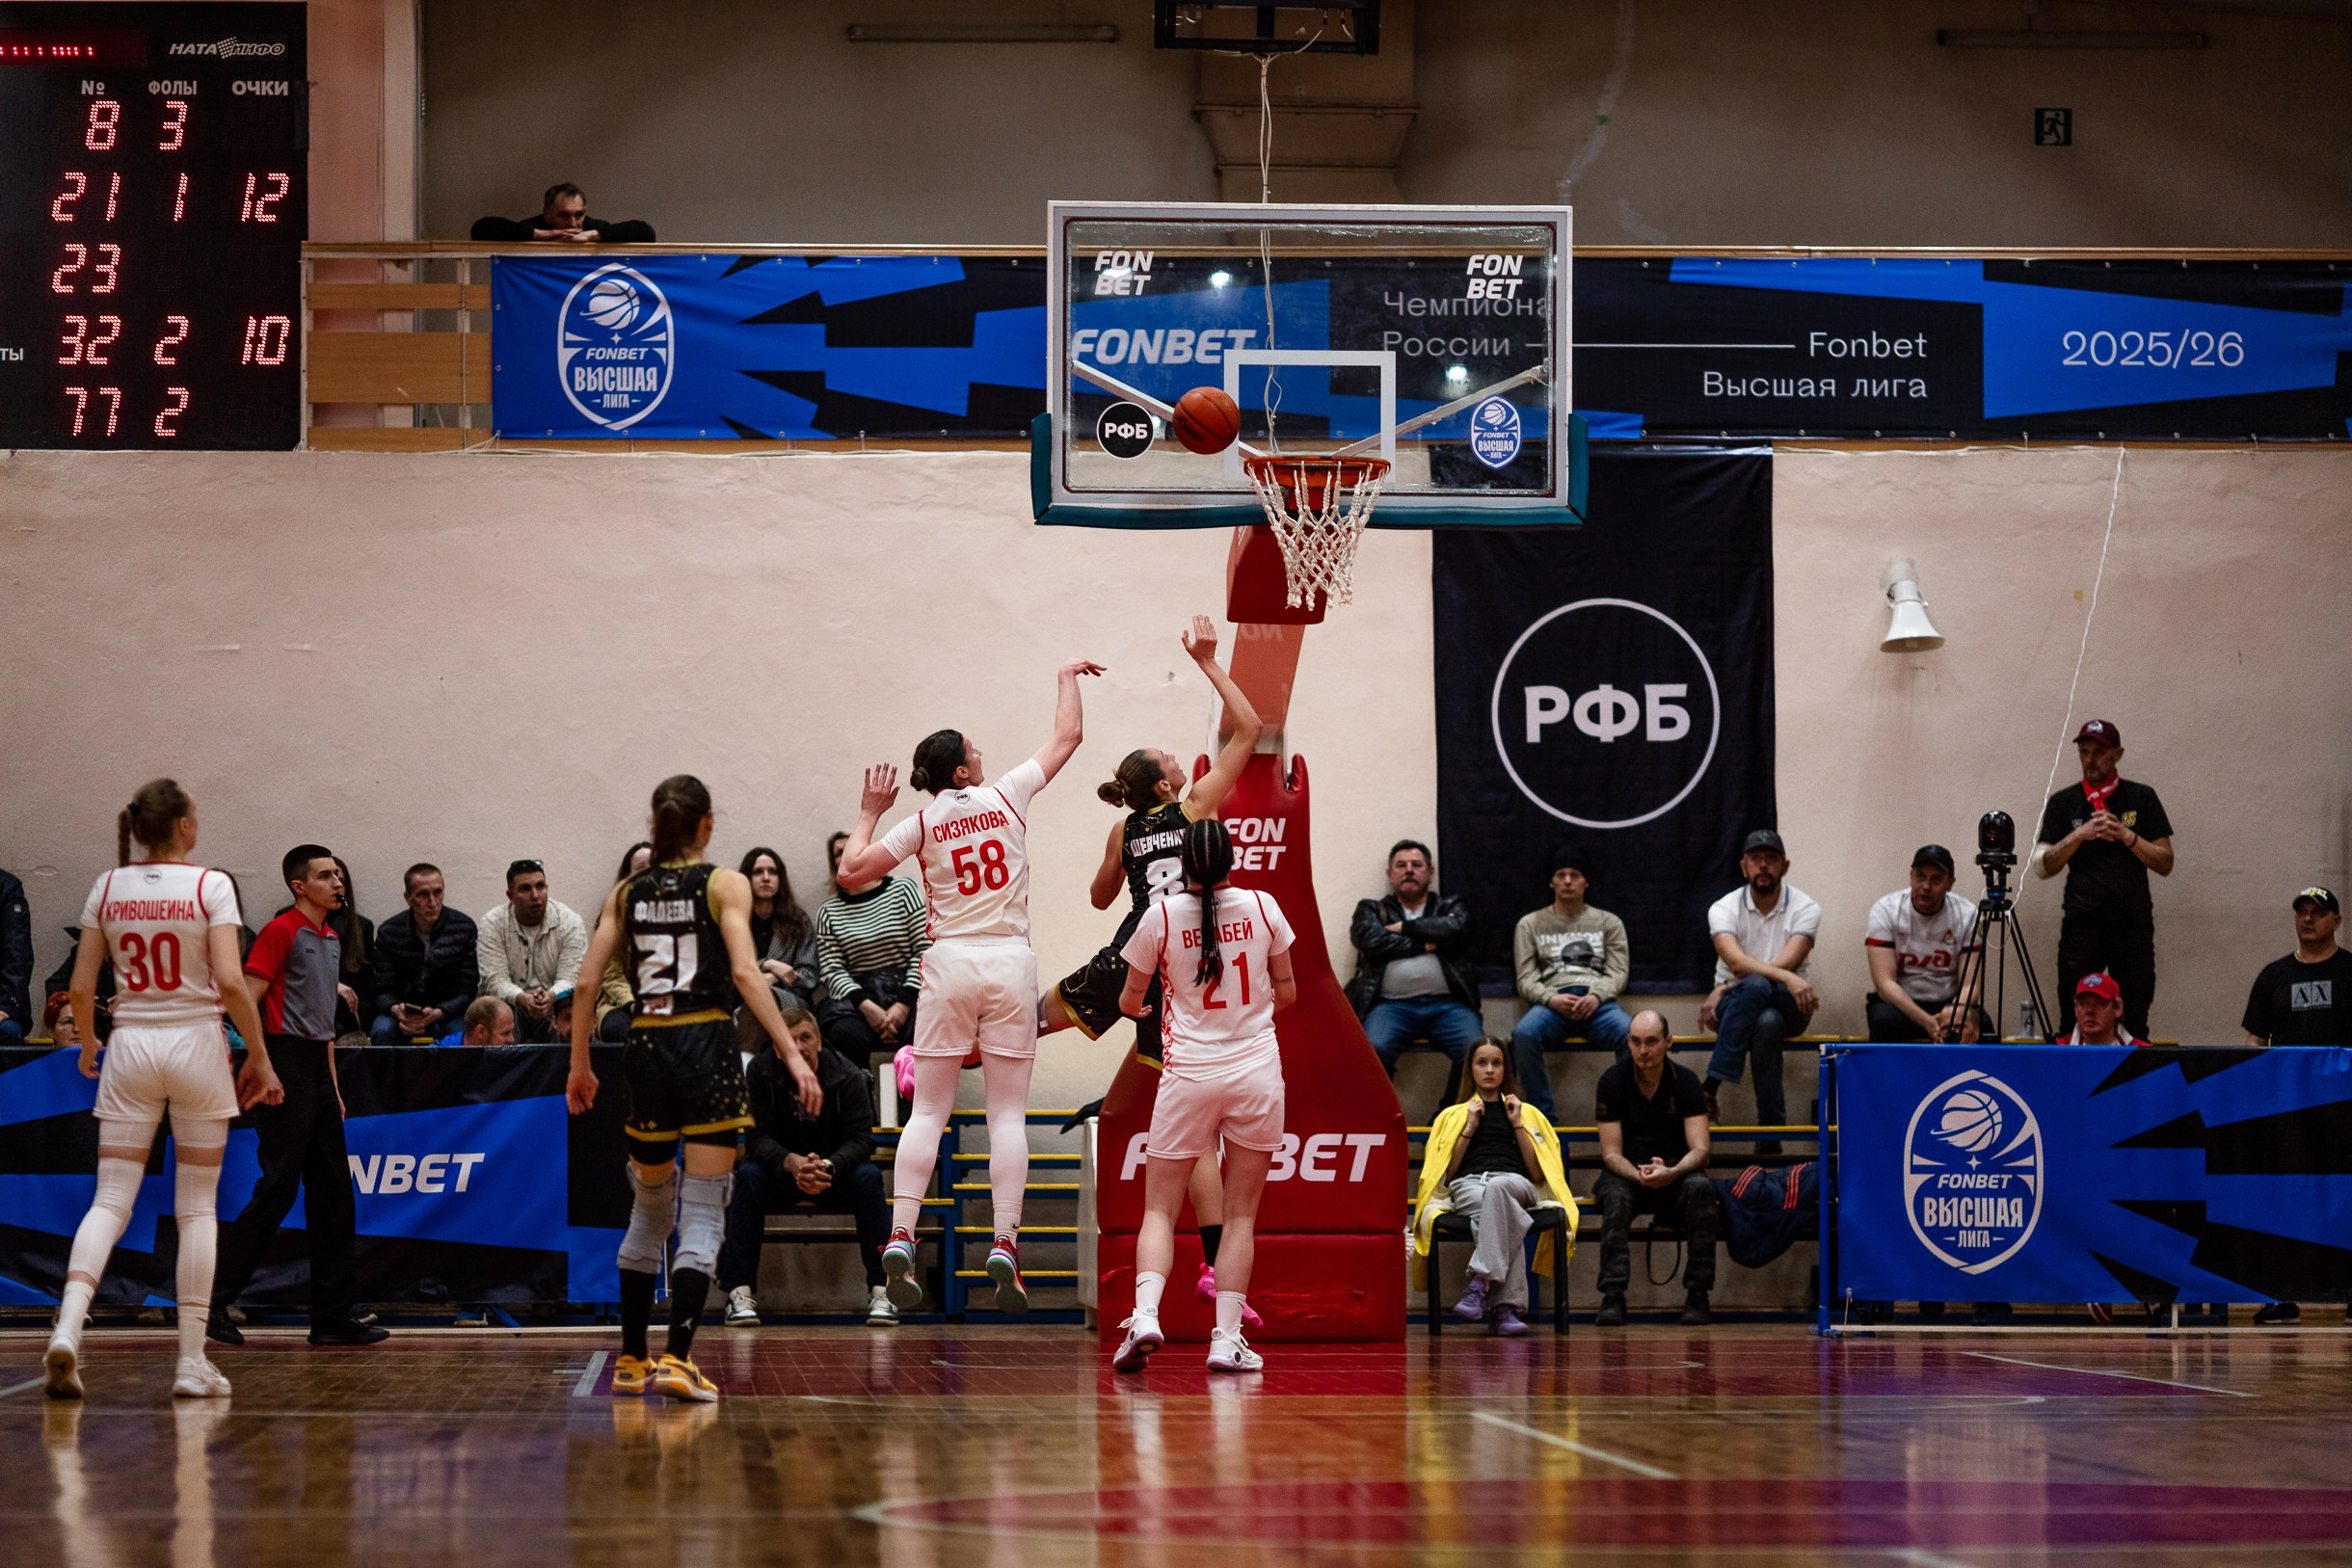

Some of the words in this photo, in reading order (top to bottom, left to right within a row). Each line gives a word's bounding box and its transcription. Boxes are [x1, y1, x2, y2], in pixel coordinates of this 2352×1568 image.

[170, 42, 218, 55] НАТА
[81, 80, 105, 94] №
[148, 80, 198, 95] ФОЛЫ
[231, 80, 289, 96] ОЧКИ
[85, 100, 120, 150] 8
[159, 100, 188, 150] 3
[51, 172, 120, 222] 21
[174, 172, 188, 222] 1
[241, 172, 289, 222] 12
[51, 243, 120, 293] 23
[1094, 251, 1155, 272] FON
[1466, 254, 1524, 276] FON
[1094, 275, 1152, 296] BET
[1466, 279, 1524, 300] BET
[59, 315, 120, 365] 32
[153, 315, 189, 365] 2
[241, 315, 290, 365] 10
[1071, 329, 1257, 364] FONBET
[1383, 331, 1510, 357] России
[1809, 331, 1928, 358] Fonbet
[2062, 329, 2245, 369] 2025/26
[586, 348, 649, 360] FONBET
[575, 366, 657, 392] ВЫСШАЯ
[1703, 371, 1836, 397] Высшая
[1851, 378, 1928, 398] лига
[66, 386, 121, 436] 77
[153, 386, 189, 436] 2
[602, 394, 630, 408] ЛИГА
[1105, 422, 1148, 439] РФБ
[1478, 440, 1514, 452] ВЫСШАЯ
[1524, 683, 1691, 743] РФБ
[932, 810, 1009, 843] СИЗЯКОВА
[1223, 817, 1287, 843] FON
[950, 839, 1009, 896] 58
[1230, 845, 1287, 871] BET
[1146, 856, 1185, 907] 8
[105, 900, 196, 923] КРИВОШЕИНА
[1182, 917, 1253, 949] ВЕАБЕЙ
[120, 932, 181, 992] 30
[633, 932, 698, 995] 21
[1197, 951, 1251, 1011] 21
[1119, 1131, 1387, 1183] FBET
[1938, 1174, 2013, 1188] FONBET
[1924, 1197, 2023, 1227] ВЫСШАЯ
[1958, 1230, 1991, 1248] ЛИГА
